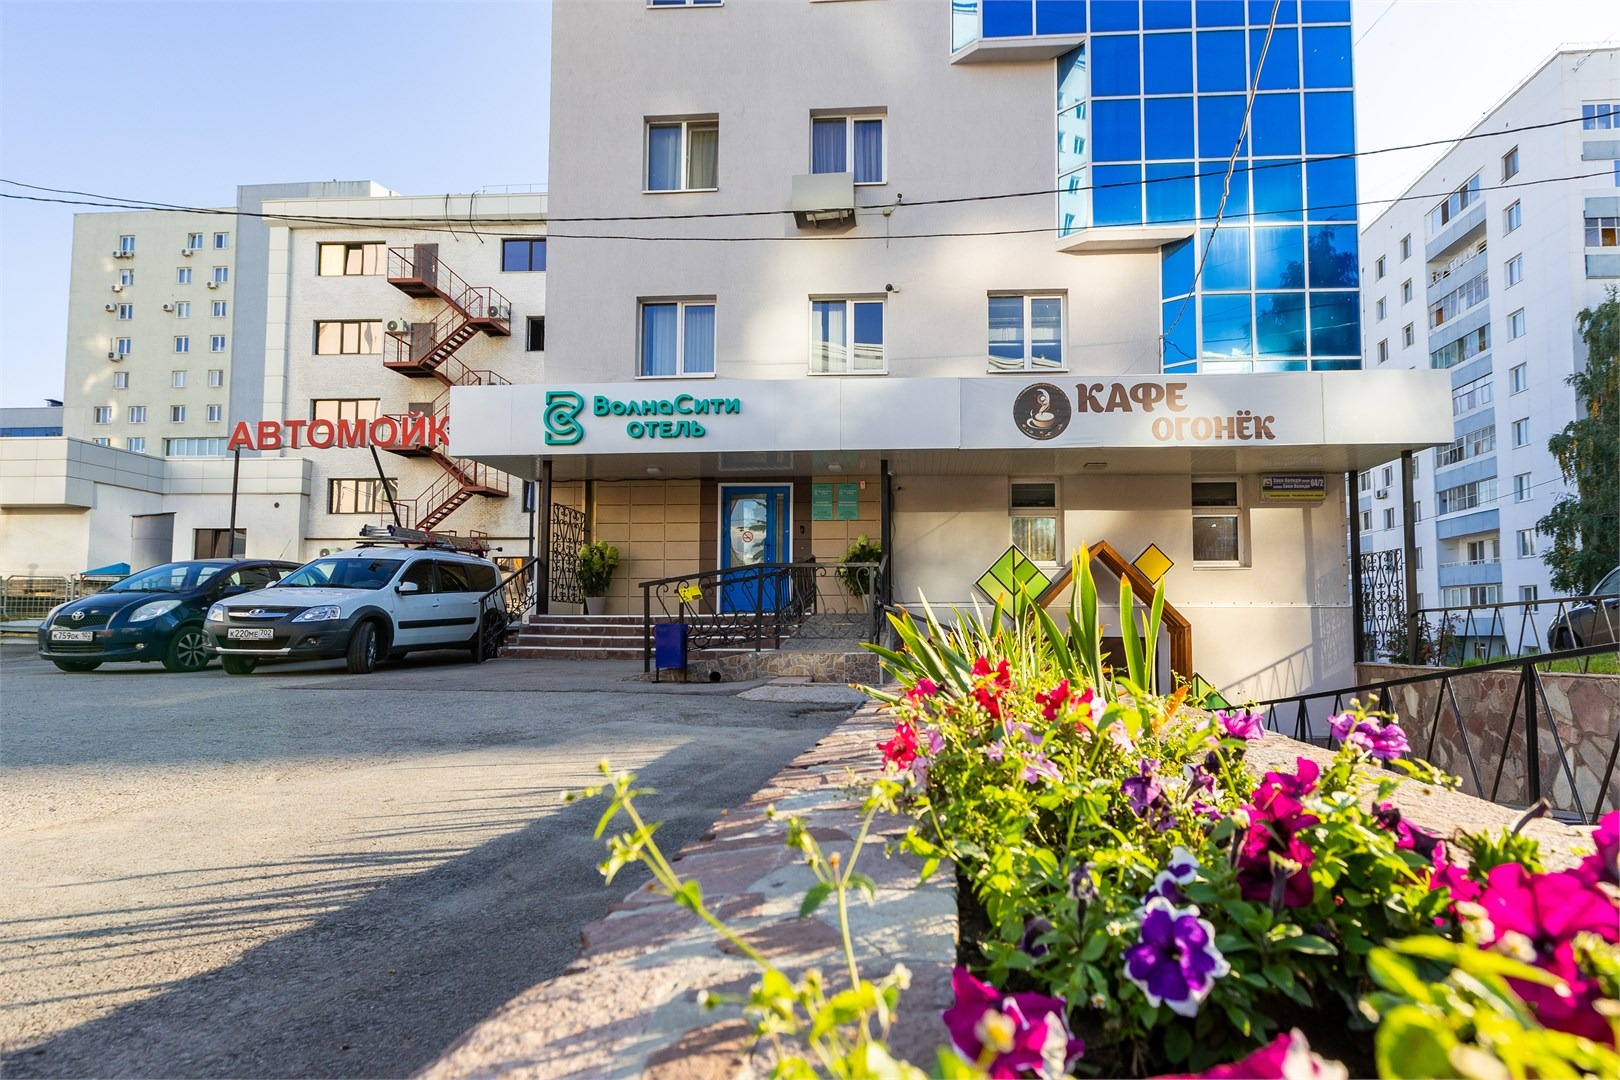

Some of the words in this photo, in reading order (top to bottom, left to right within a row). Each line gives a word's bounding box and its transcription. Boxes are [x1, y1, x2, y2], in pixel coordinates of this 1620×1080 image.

[593, 393, 741, 416] ВолнаСити
[1075, 382, 1189, 413] КАФЕ
[626, 420, 706, 439] ОТЕЛЬ
[1151, 410, 1276, 442] ОГОНЁК
[1310, 479, 1324, 487] 64/2
